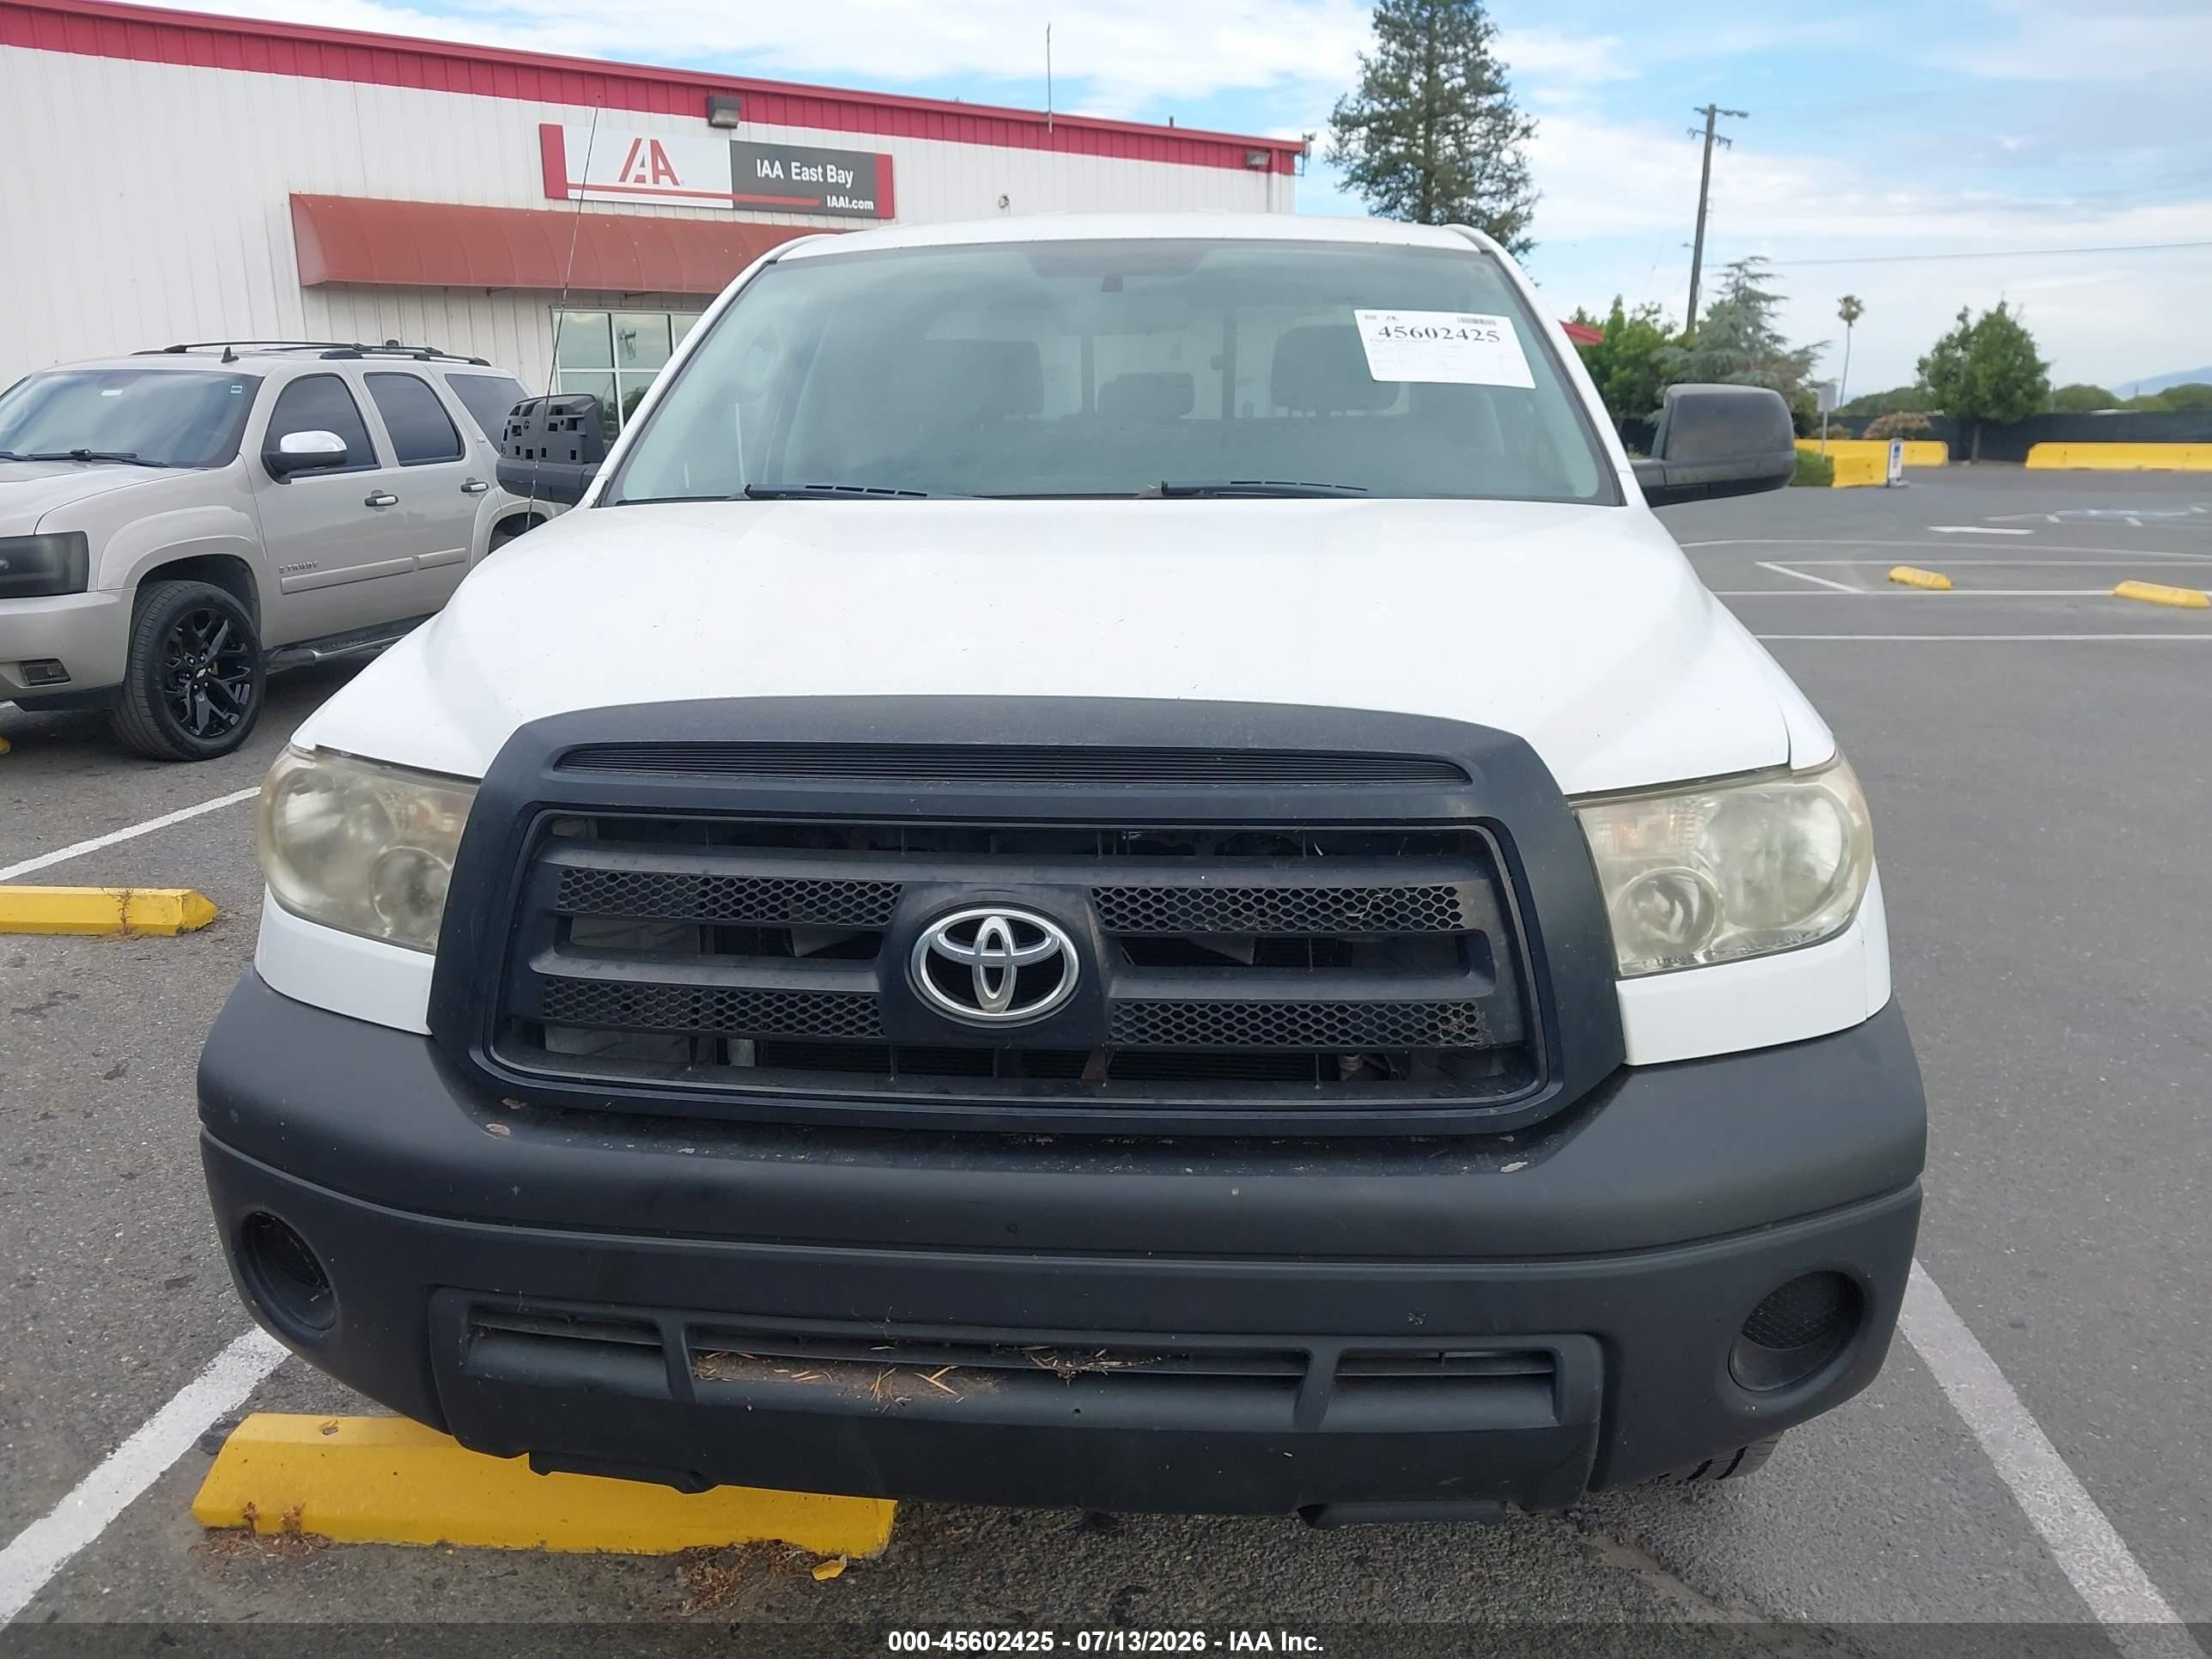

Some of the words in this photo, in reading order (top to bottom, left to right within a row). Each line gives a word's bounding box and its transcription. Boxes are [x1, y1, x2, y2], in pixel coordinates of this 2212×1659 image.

[756, 158, 785, 179] IAA
[790, 161, 824, 182] East
[826, 164, 854, 189] Bay
[826, 194, 875, 210] IAAI.com
[1377, 325, 1501, 343] 45602425
